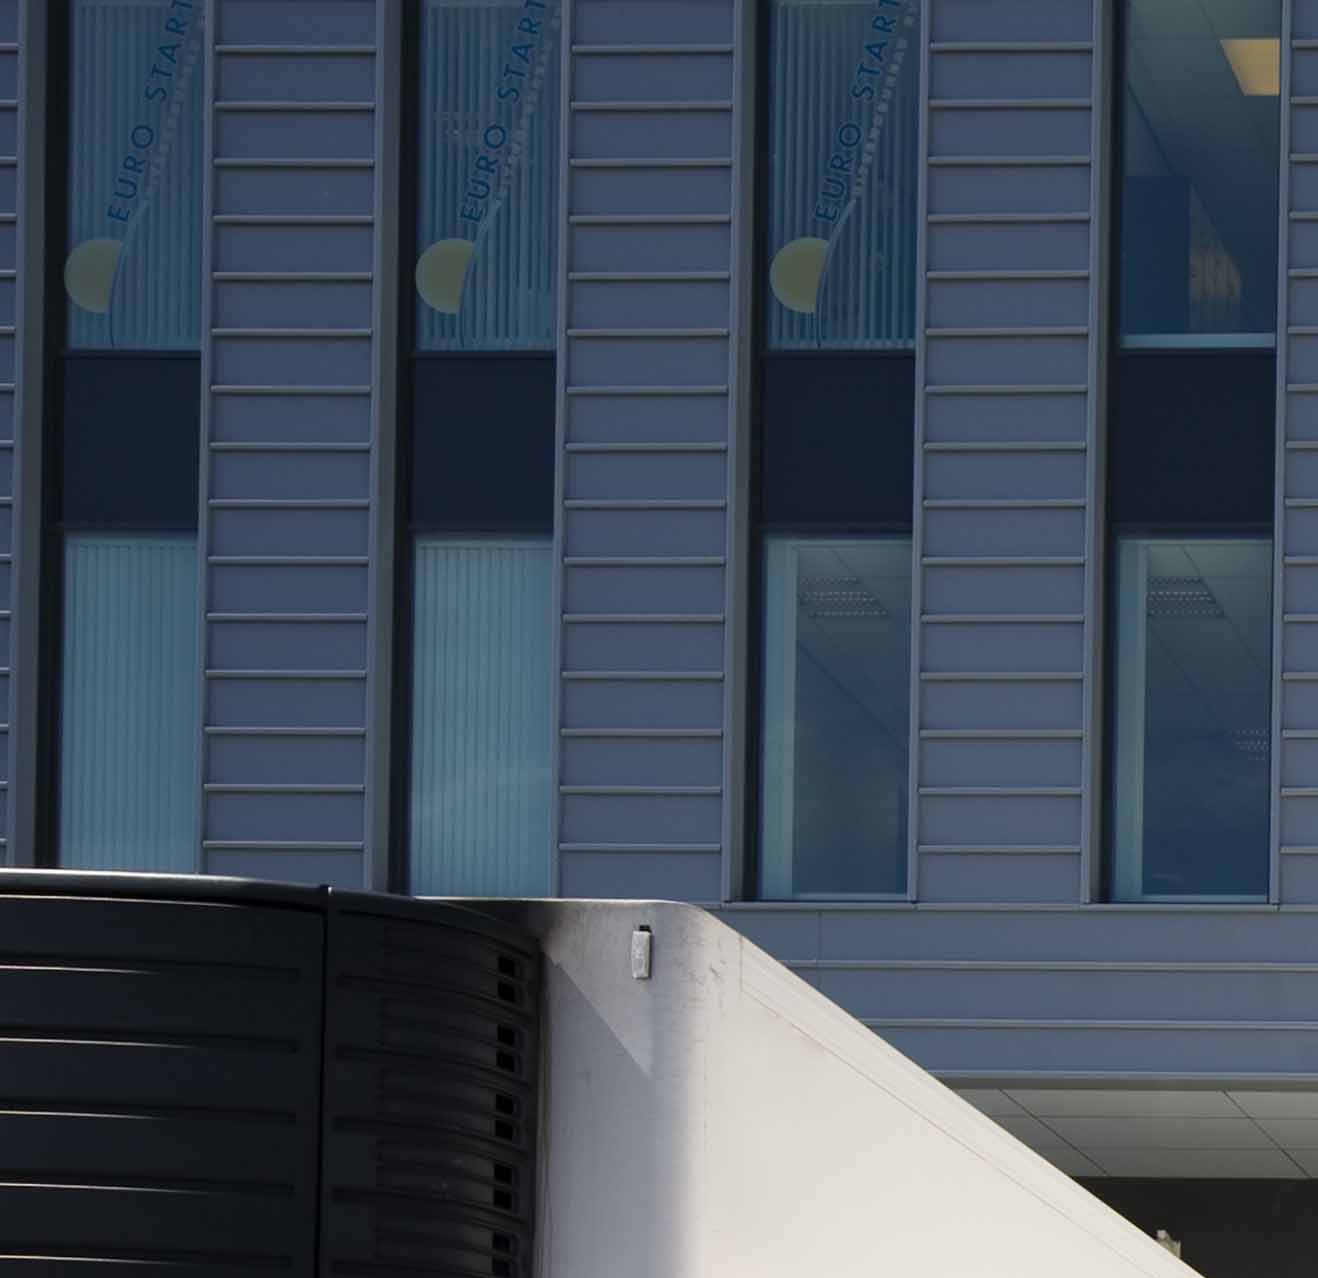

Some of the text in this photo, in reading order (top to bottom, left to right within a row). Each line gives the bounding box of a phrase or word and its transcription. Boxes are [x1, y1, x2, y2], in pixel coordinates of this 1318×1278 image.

[107, 125, 154, 222] EURO
[461, 124, 507, 222] EURO
[815, 123, 862, 222] EURO
